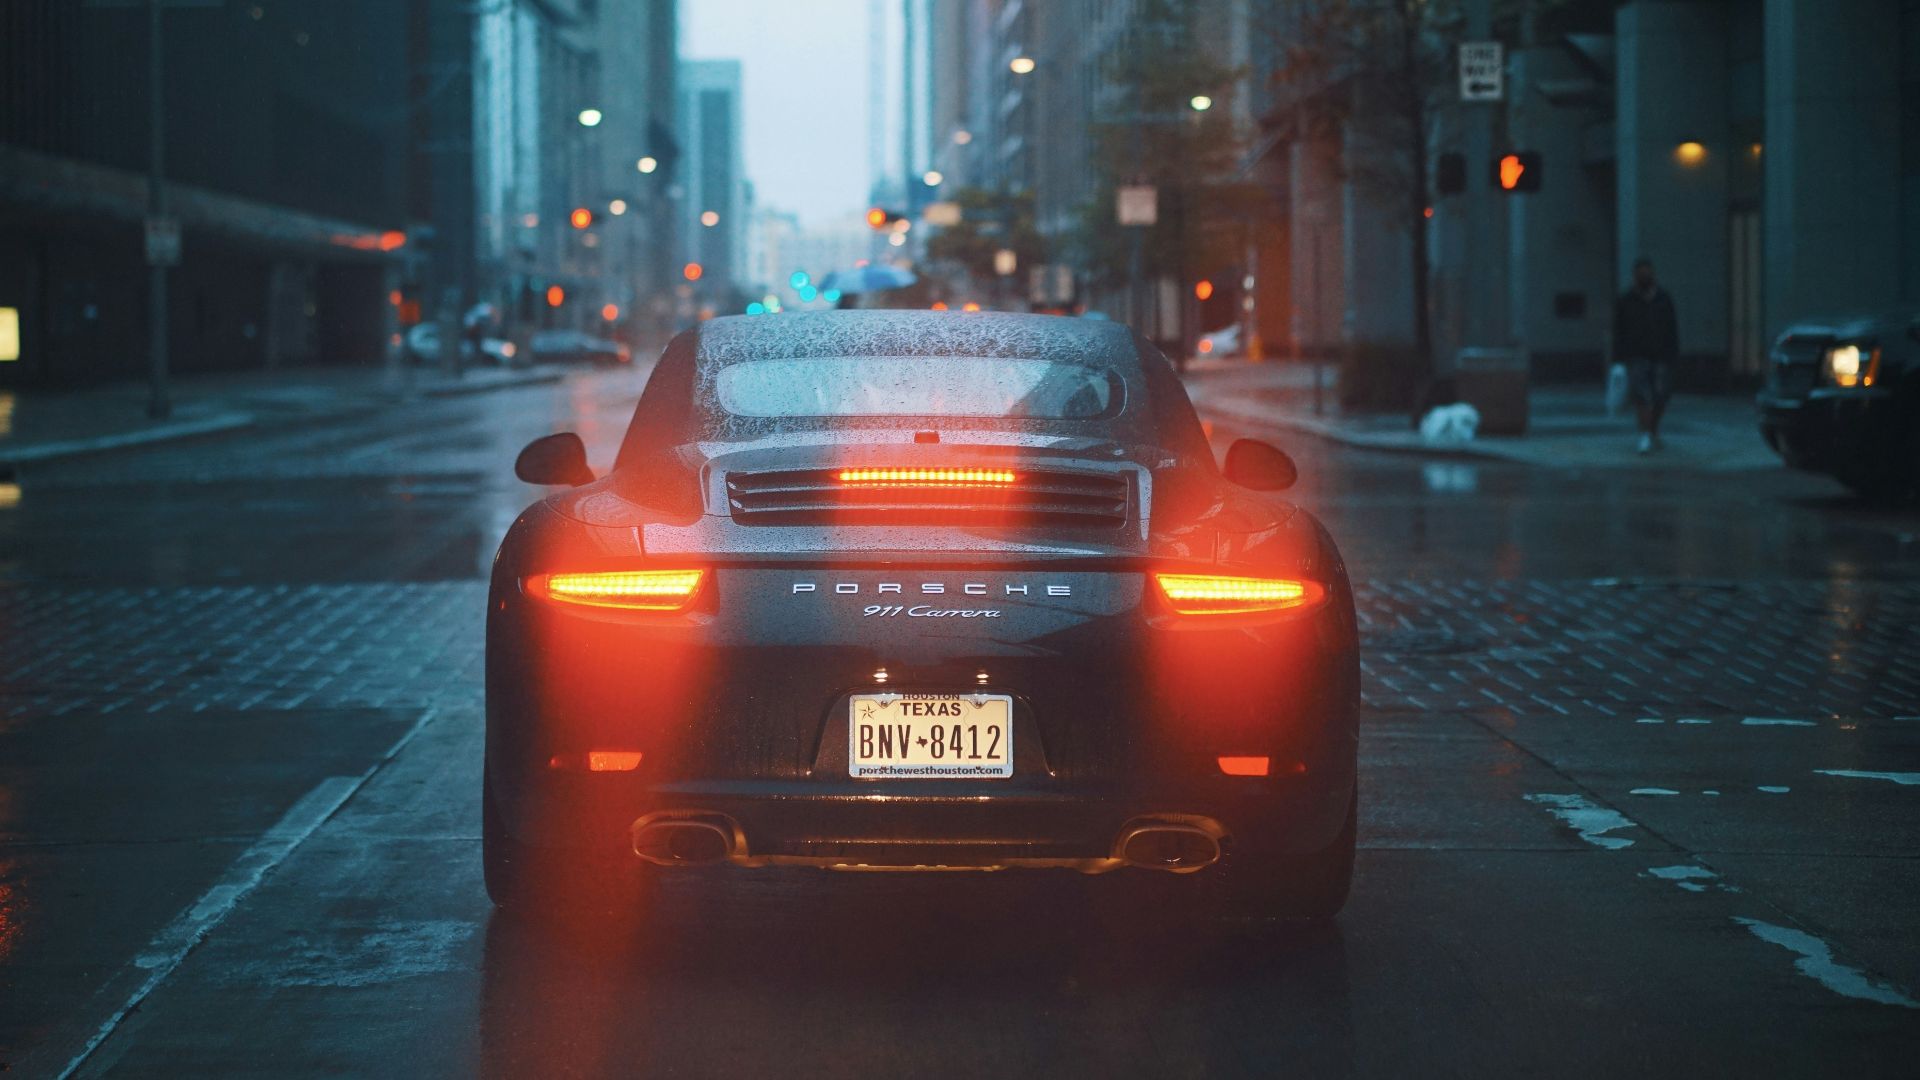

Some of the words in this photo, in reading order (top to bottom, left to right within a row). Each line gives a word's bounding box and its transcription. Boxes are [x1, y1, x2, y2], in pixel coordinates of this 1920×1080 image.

[793, 583, 1071, 596] PORSCHE
[863, 605, 904, 617] 911
[907, 605, 1001, 618] Carrera
[900, 702, 962, 717] TEXAS
[860, 724, 911, 759] BNV
[930, 724, 1001, 759] 8412
[858, 765, 1004, 776] porschewesthouston.com
